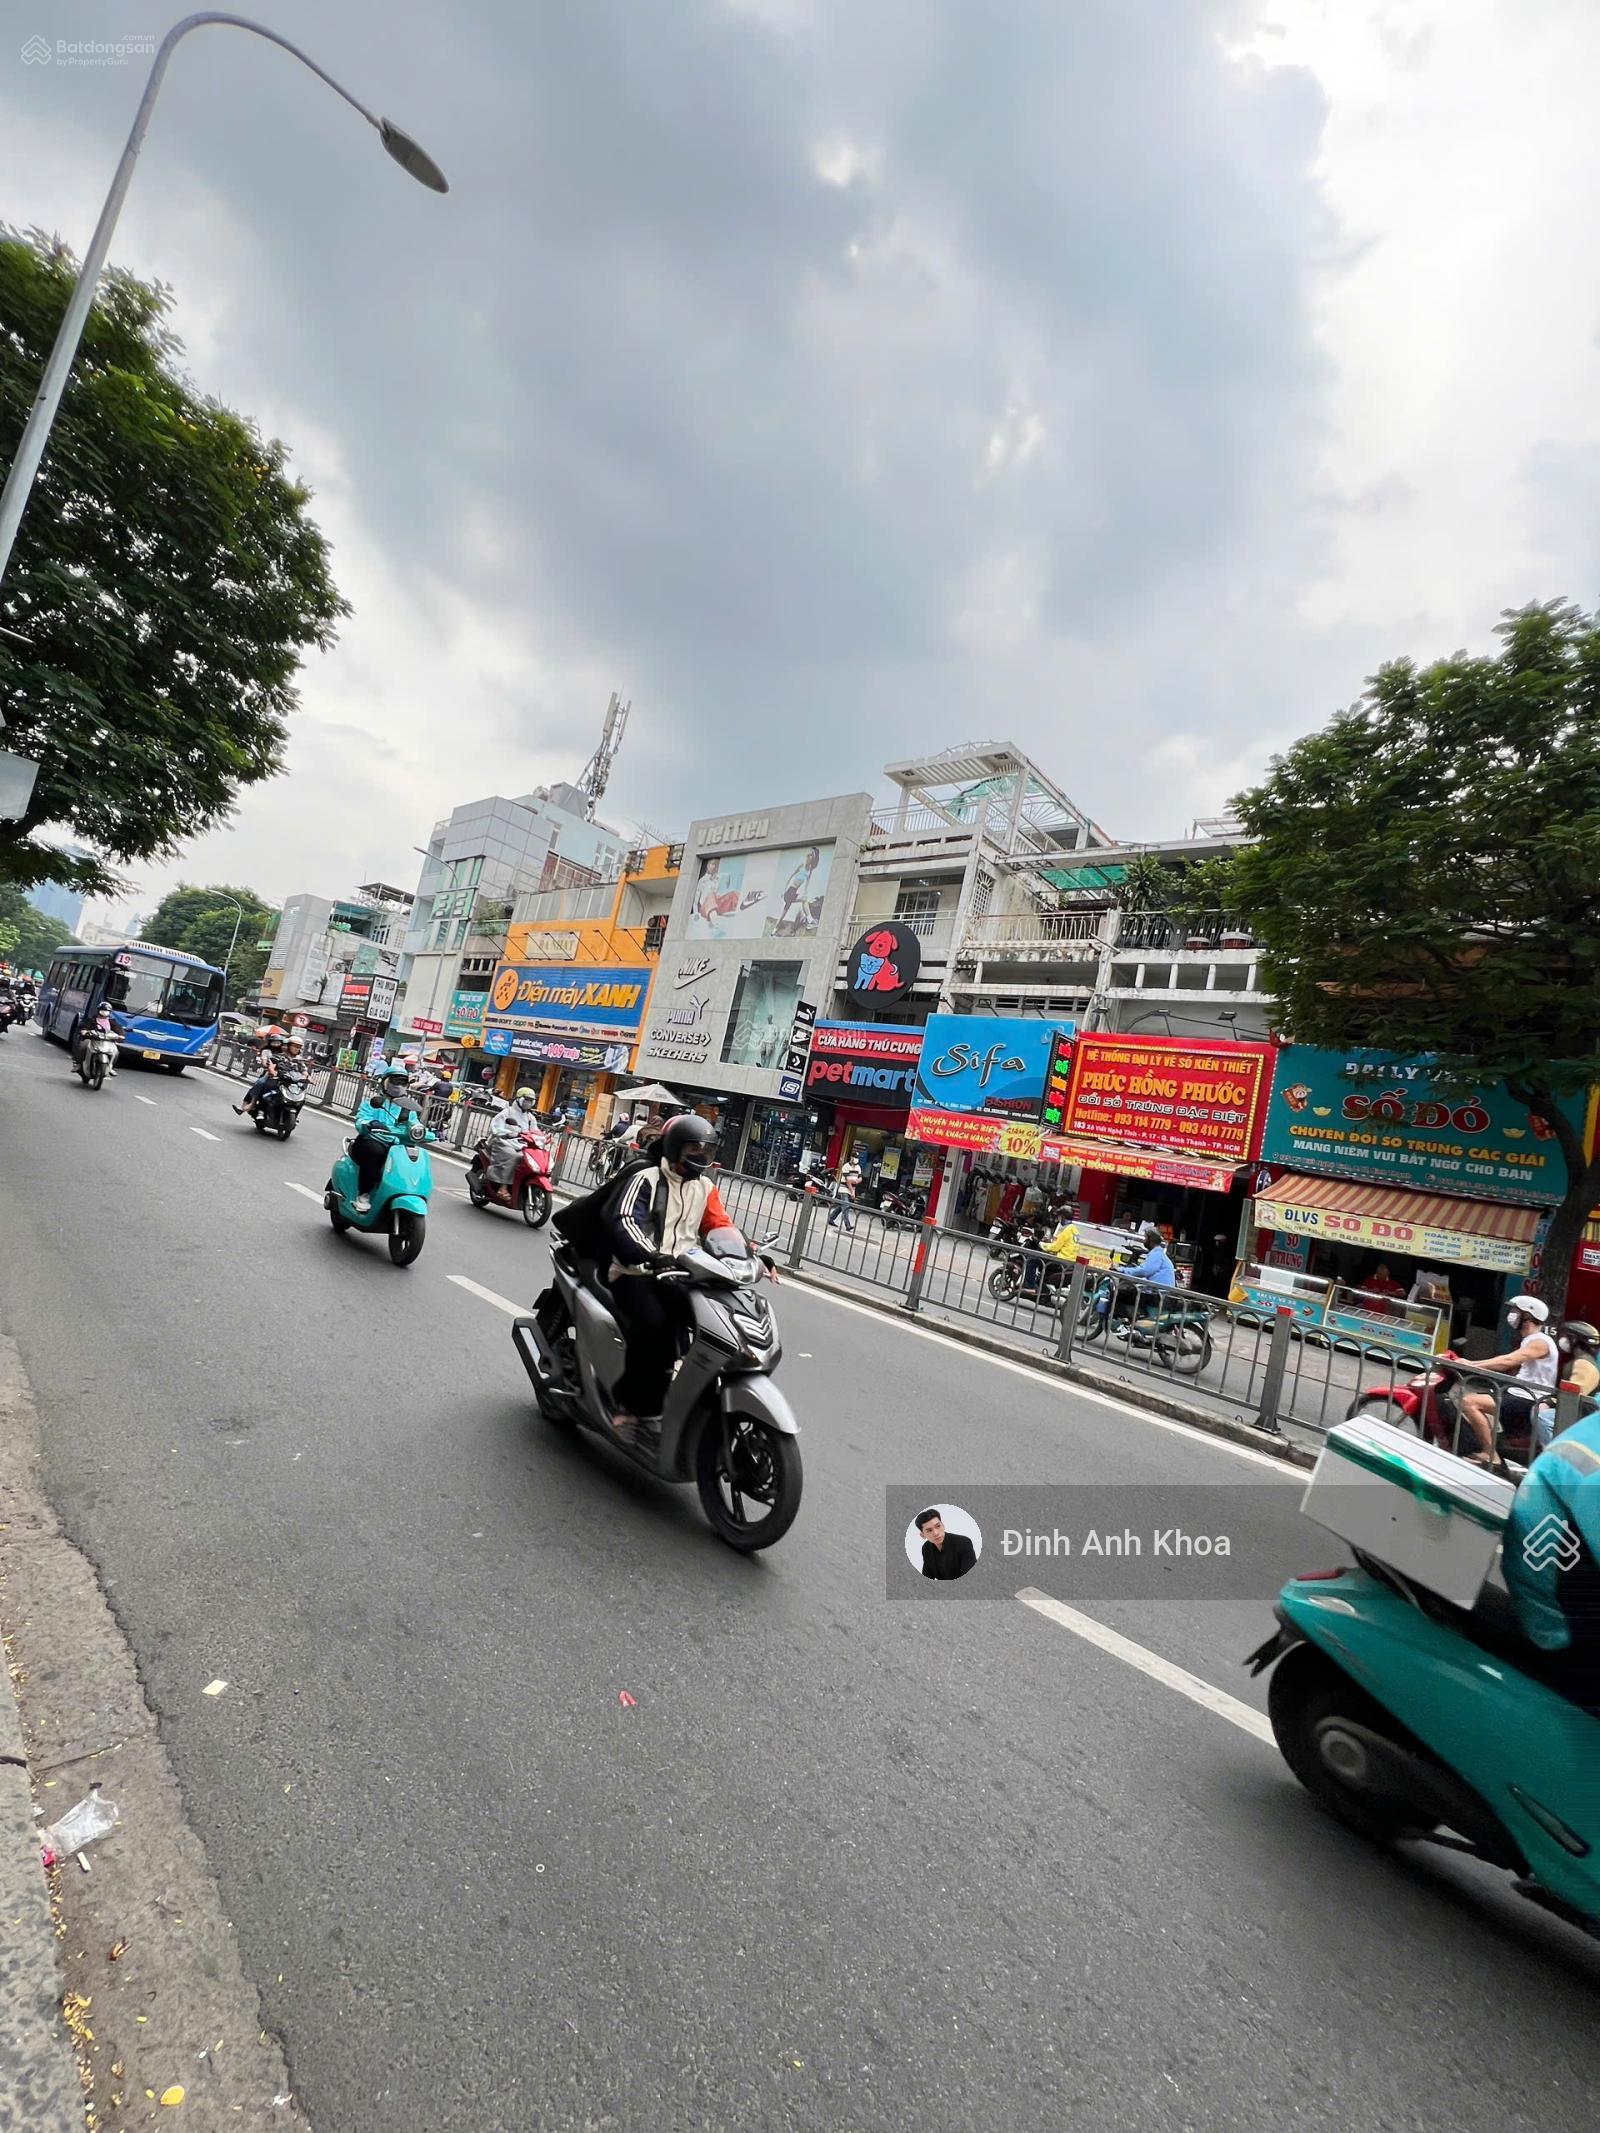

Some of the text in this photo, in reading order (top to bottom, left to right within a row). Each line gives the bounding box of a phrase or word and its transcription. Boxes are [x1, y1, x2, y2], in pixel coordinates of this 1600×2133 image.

[118, 954, 131, 964] 19
[678, 957, 710, 979] NIKE
[517, 980, 642, 1010] Điện máy XANH
[667, 1009, 696, 1025] PUMA
[649, 1028, 700, 1044] CONVERSE
[817, 1033, 837, 1047] CỬA
[837, 1035, 866, 1049] HÀNG
[866, 1038, 890, 1051] THÚ
[647, 1047, 708, 1064] SKECHERS
[931, 1043, 1026, 1087] Sifa
[1100, 1049, 1130, 1064] THỐNG
[1131, 1053, 1148, 1067] ĐẠI
[1149, 1053, 1162, 1066] LÝ
[1164, 1054, 1176, 1067] VÉ
[1178, 1055, 1193, 1069] SỐ
[1194, 1057, 1219, 1071] KIẾN
[1222, 1059, 1253, 1074] THIẾT
[807, 1060, 917, 1093] petmart
[1081, 1069, 1127, 1093] PHÚC
[1127, 1068, 1177, 1098] HỒNG
[1180, 1080, 1247, 1106] PHƯỚC
[1103, 1094, 1122, 1108] SỐ
[1126, 1098, 1174, 1115] TRÚNG
[1176, 1105, 1208, 1120] ĐẶC
[1211, 1109, 1247, 1124] BIỆT
[1341, 1088, 1491, 1133] SỐ ĐỎ
[1074, 1108, 1112, 1122] Hotline:
[1113, 1112, 1132, 1126] 093
[1134, 1115, 1149, 1128] 114
[1151, 1116, 1172, 1131] 7779
[1179, 1121, 1199, 1135] 093
[1200, 1124, 1219, 1138] 414
[1220, 1126, 1244, 1140] 7779
[1006, 1137, 1036, 1155] 10%
[1223, 1143, 1240, 1152] HCM
[1293, 1139, 1331, 1153] MANG
[1373, 1150, 1396, 1162] VUI
[1465, 1162, 1494, 1175] CHO
[1284, 1208, 1319, 1225] ĐLVS
